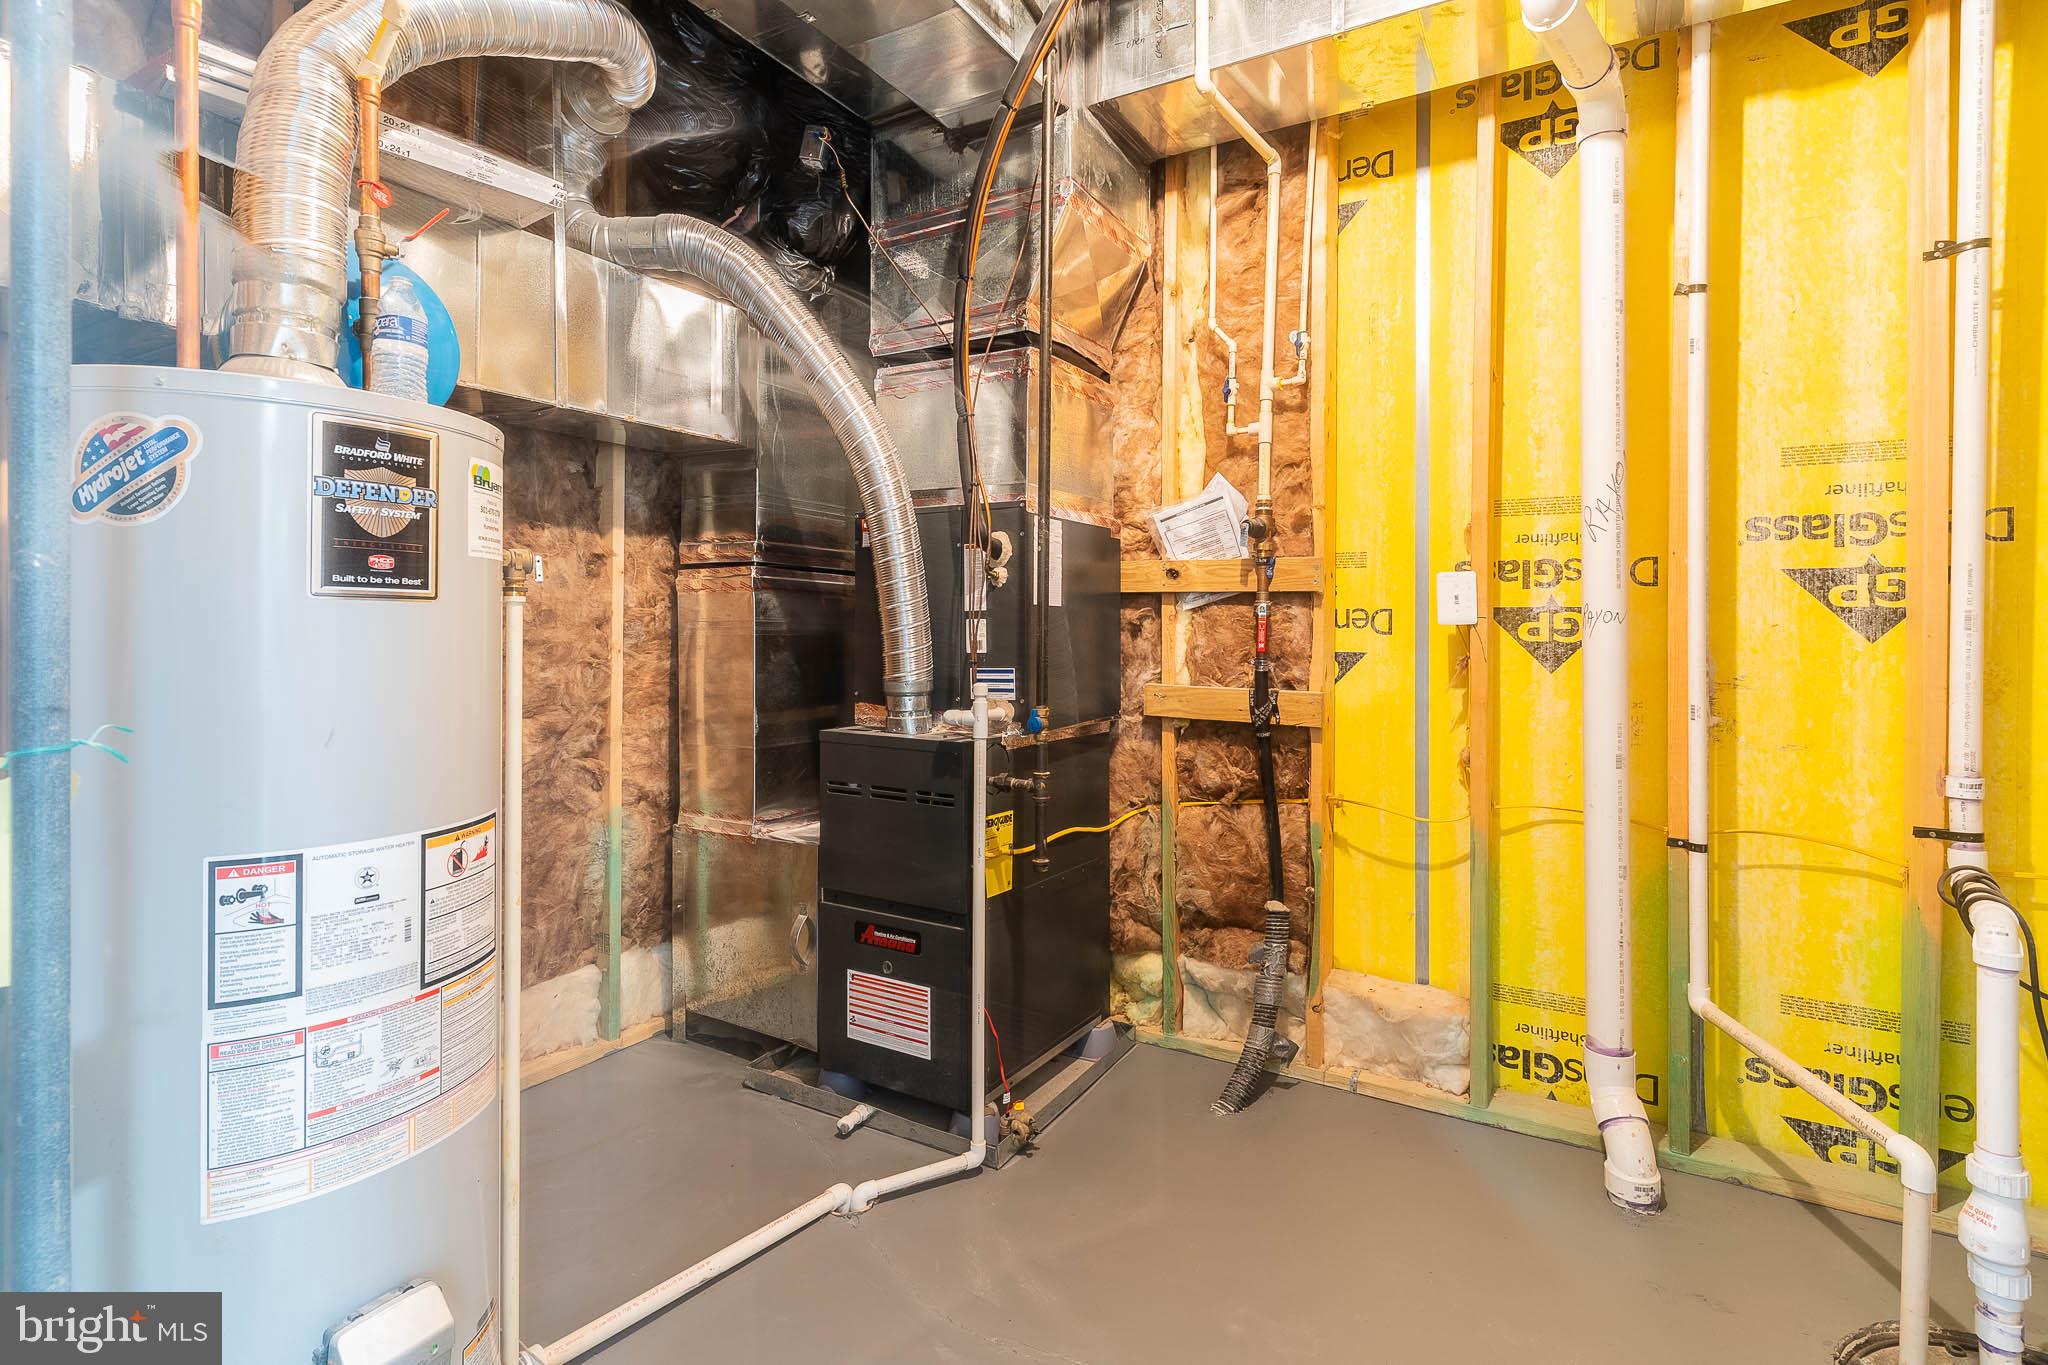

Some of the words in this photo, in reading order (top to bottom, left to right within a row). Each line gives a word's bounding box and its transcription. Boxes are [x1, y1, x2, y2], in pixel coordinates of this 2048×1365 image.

[334, 444, 392, 461] BRADFORD
[393, 452, 425, 466] WHITE
[341, 455, 418, 470] CORPORATION
[77, 447, 147, 506] Hydrojet
[314, 476, 437, 508] DEFENDER
[1824, 480, 1907, 499] haftliner
[335, 503, 378, 516] SAFETY
[380, 507, 423, 520] SYSTEM
[1513, 531, 1582, 548] haftliner
[332, 574, 356, 583] Built
[356, 576, 368, 584] to
[370, 576, 383, 584] be
[385, 577, 400, 585] the
[401, 577, 423, 586] Best
[312, 852, 347, 861] AUTOMATIC
[348, 847, 375, 857] STORAGE
[376, 844, 394, 852] WATER
[395, 840, 416, 849] HEATER
[242, 864, 287, 877] DANGER
[255, 901, 272, 909] HOT
[860, 923, 916, 953] Amana
